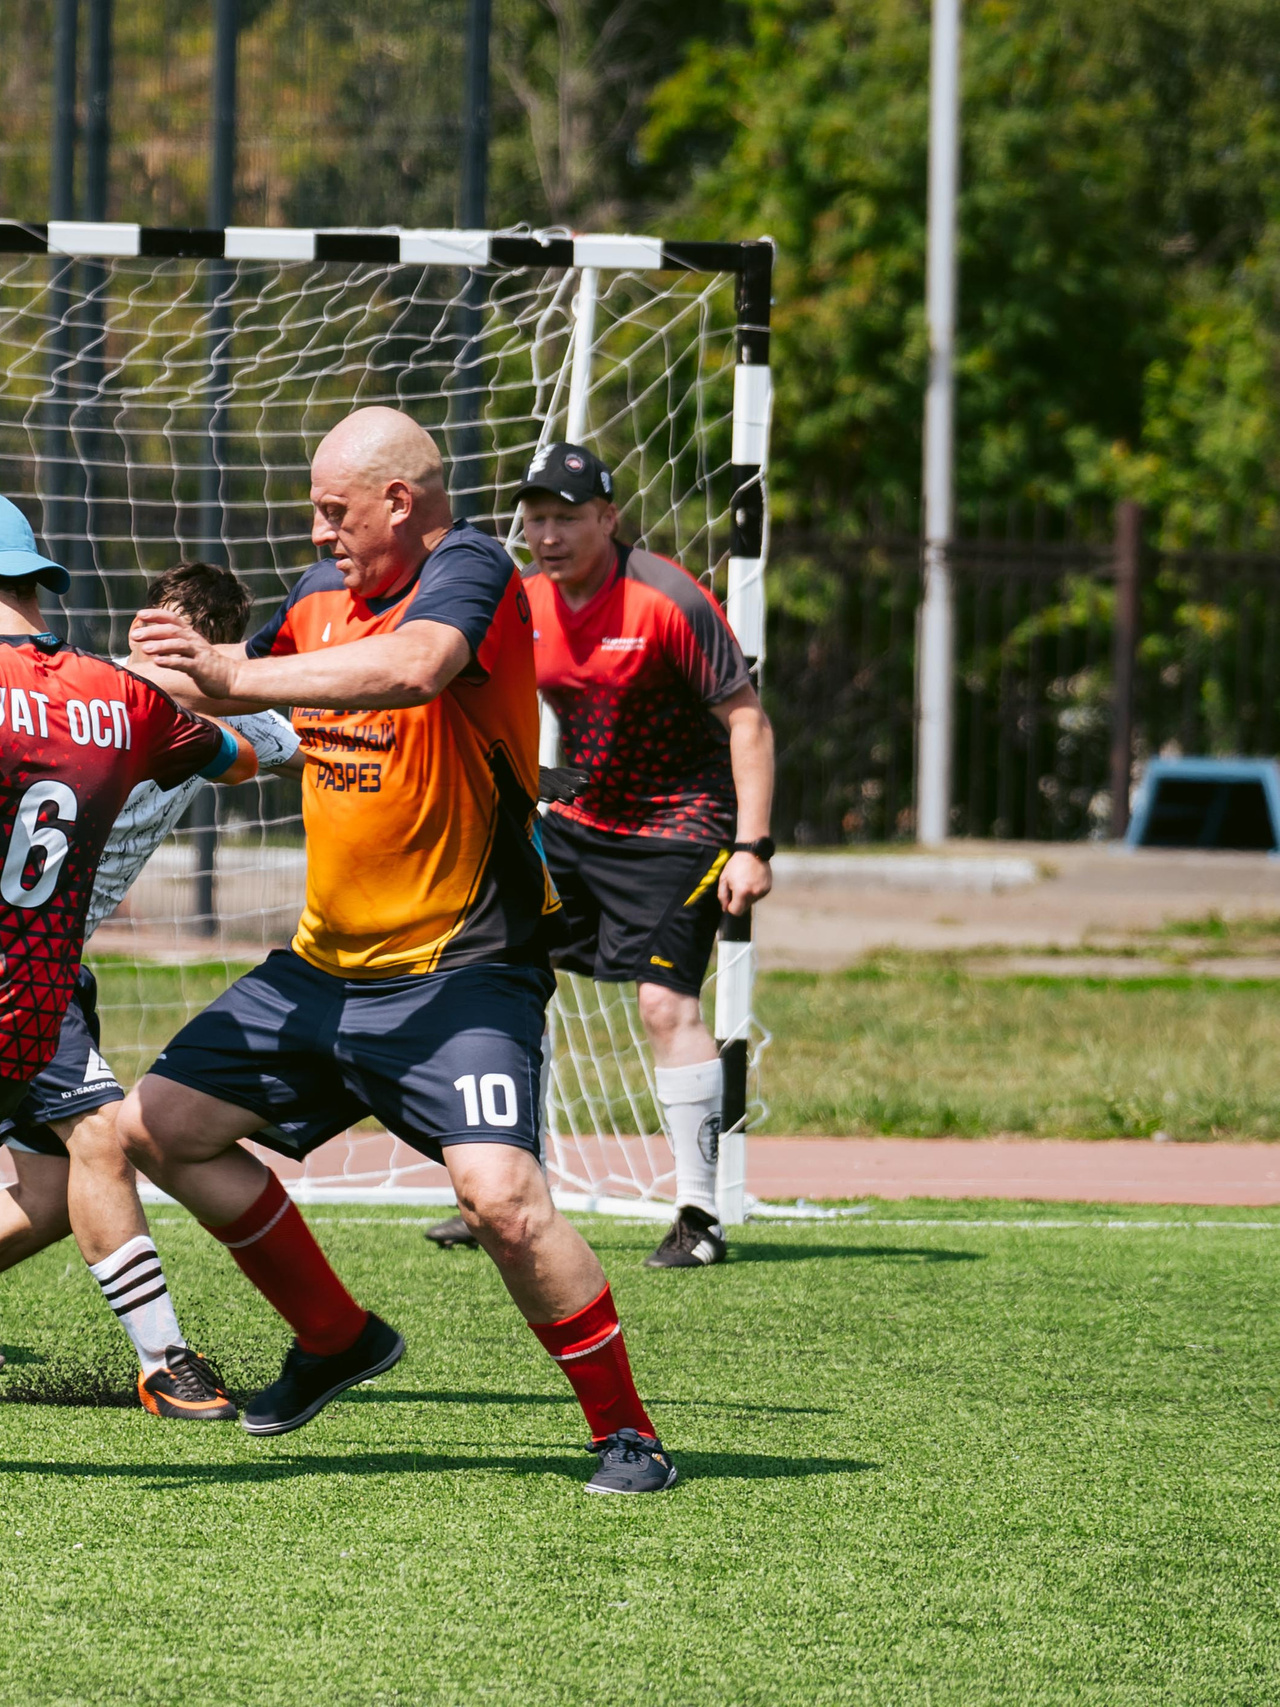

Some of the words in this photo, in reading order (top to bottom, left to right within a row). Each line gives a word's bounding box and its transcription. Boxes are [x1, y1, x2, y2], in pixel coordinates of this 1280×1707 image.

[66, 698, 132, 752] ОСП
[124, 795, 145, 814] NIKE
[316, 762, 382, 793] РАЗРЕЗ
[0, 780, 78, 909] 6
[454, 1073, 518, 1127] 10
